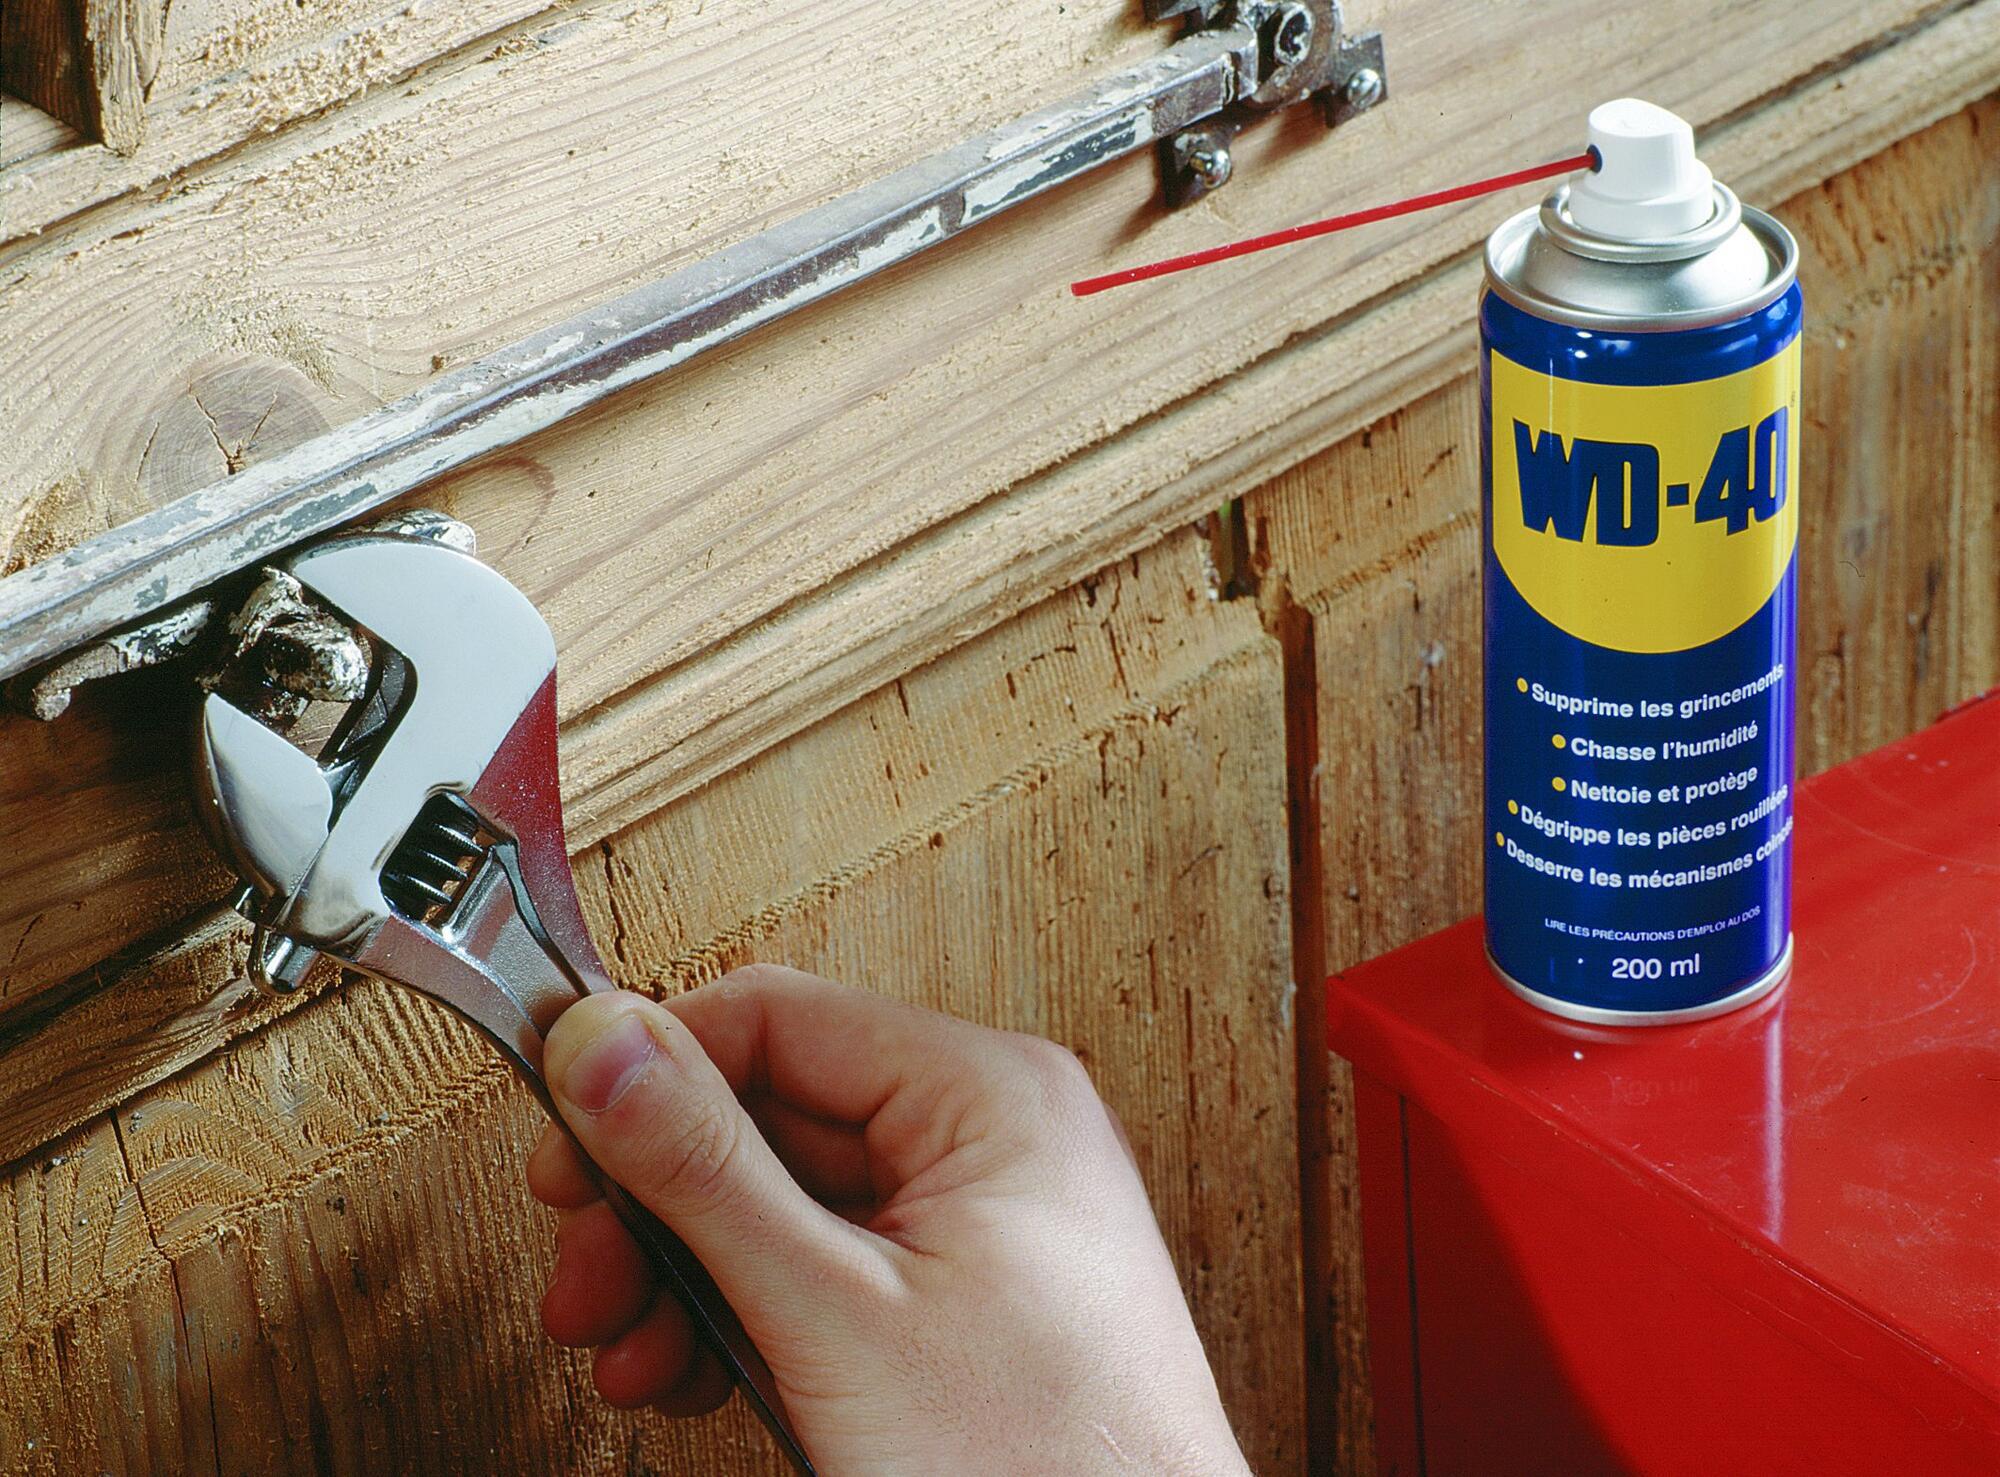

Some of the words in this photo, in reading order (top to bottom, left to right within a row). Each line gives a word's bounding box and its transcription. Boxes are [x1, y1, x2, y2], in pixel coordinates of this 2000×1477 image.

[1513, 405, 1789, 547] WD-40
[1531, 682, 1634, 718] Supprime
[1640, 700, 1674, 718] les
[1680, 662, 1785, 719] grincements
[1570, 736, 1656, 761] Chasse
[1662, 720, 1759, 760] l'humidité
[1570, 779, 1652, 804] Nettoie
[1657, 785, 1680, 804] et
[1685, 766, 1759, 804] protège
[1520, 804, 1611, 846] Dégrippe
[1617, 828, 1651, 847] les
[1657, 823, 1727, 850] pièces
[1730, 783, 1789, 832] rouillées
[1506, 837, 1584, 883] Desserre
[1589, 867, 1622, 888] les
[1628, 853, 1753, 889] mécanismes
[1544, 917, 1567, 932] LIRE
[1568, 924, 1590, 938] LES
[1591, 925, 1675, 942] PRÉCAUTIONS
[1677, 921, 1726, 940] D'EMPLOI
[1727, 916, 1741, 929] AU
[1741, 905, 1761, 923] DOS
[1611, 957, 1662, 979] 200
[1670, 952, 1701, 977] ml
